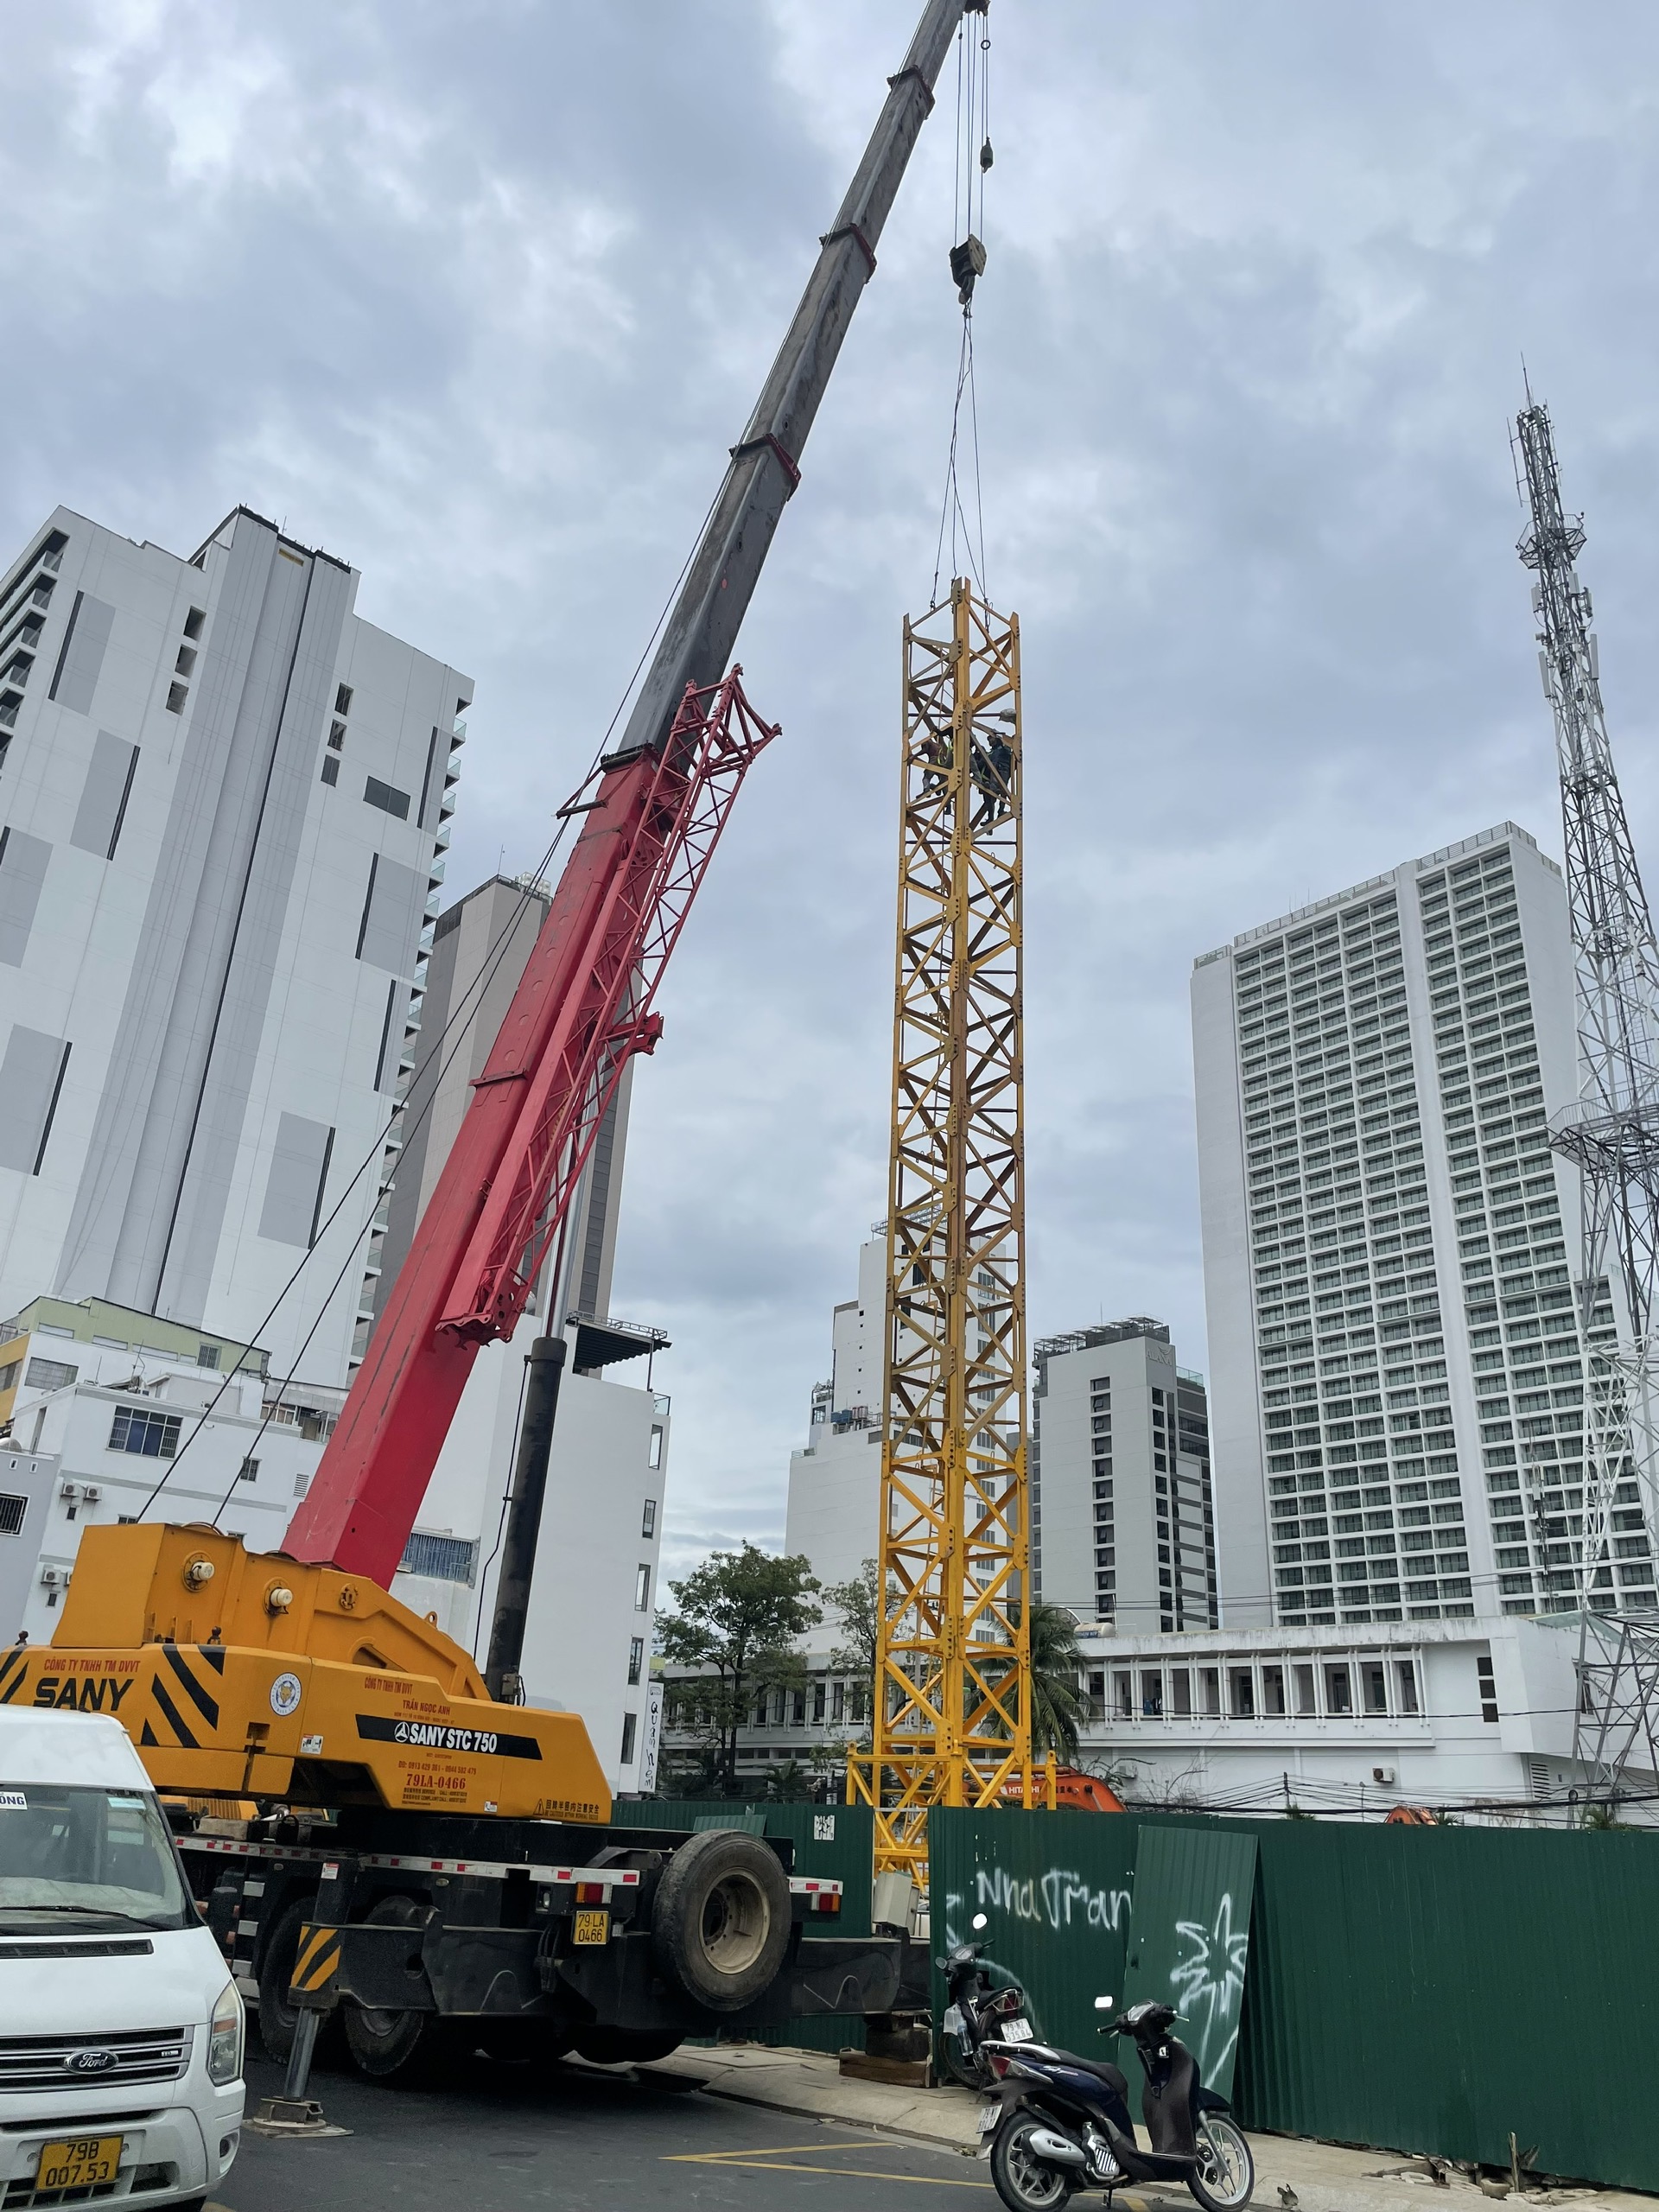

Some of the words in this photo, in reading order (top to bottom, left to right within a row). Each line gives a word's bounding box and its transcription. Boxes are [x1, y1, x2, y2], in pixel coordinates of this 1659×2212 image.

[68, 1660, 79, 1671] TY
[79, 1660, 101, 1672] TNHH
[104, 1660, 117, 1672] TM
[118, 1661, 141, 1673] DVVT
[33, 1677, 135, 1711] SANY
[438, 1705, 451, 1716] ANH
[409, 1723, 445, 1748] SANY
[446, 1728, 472, 1751] STC
[474, 1732, 498, 1753] 750
[406, 1773, 467, 1789] 79LA-0466
[976, 1866, 1041, 1923] Nha
[578, 1929, 603, 1942] 0466
[79, 2053, 108, 2068] Ford
[66, 2141, 100, 2164] 79B
[45, 2161, 110, 2188] 007.53
